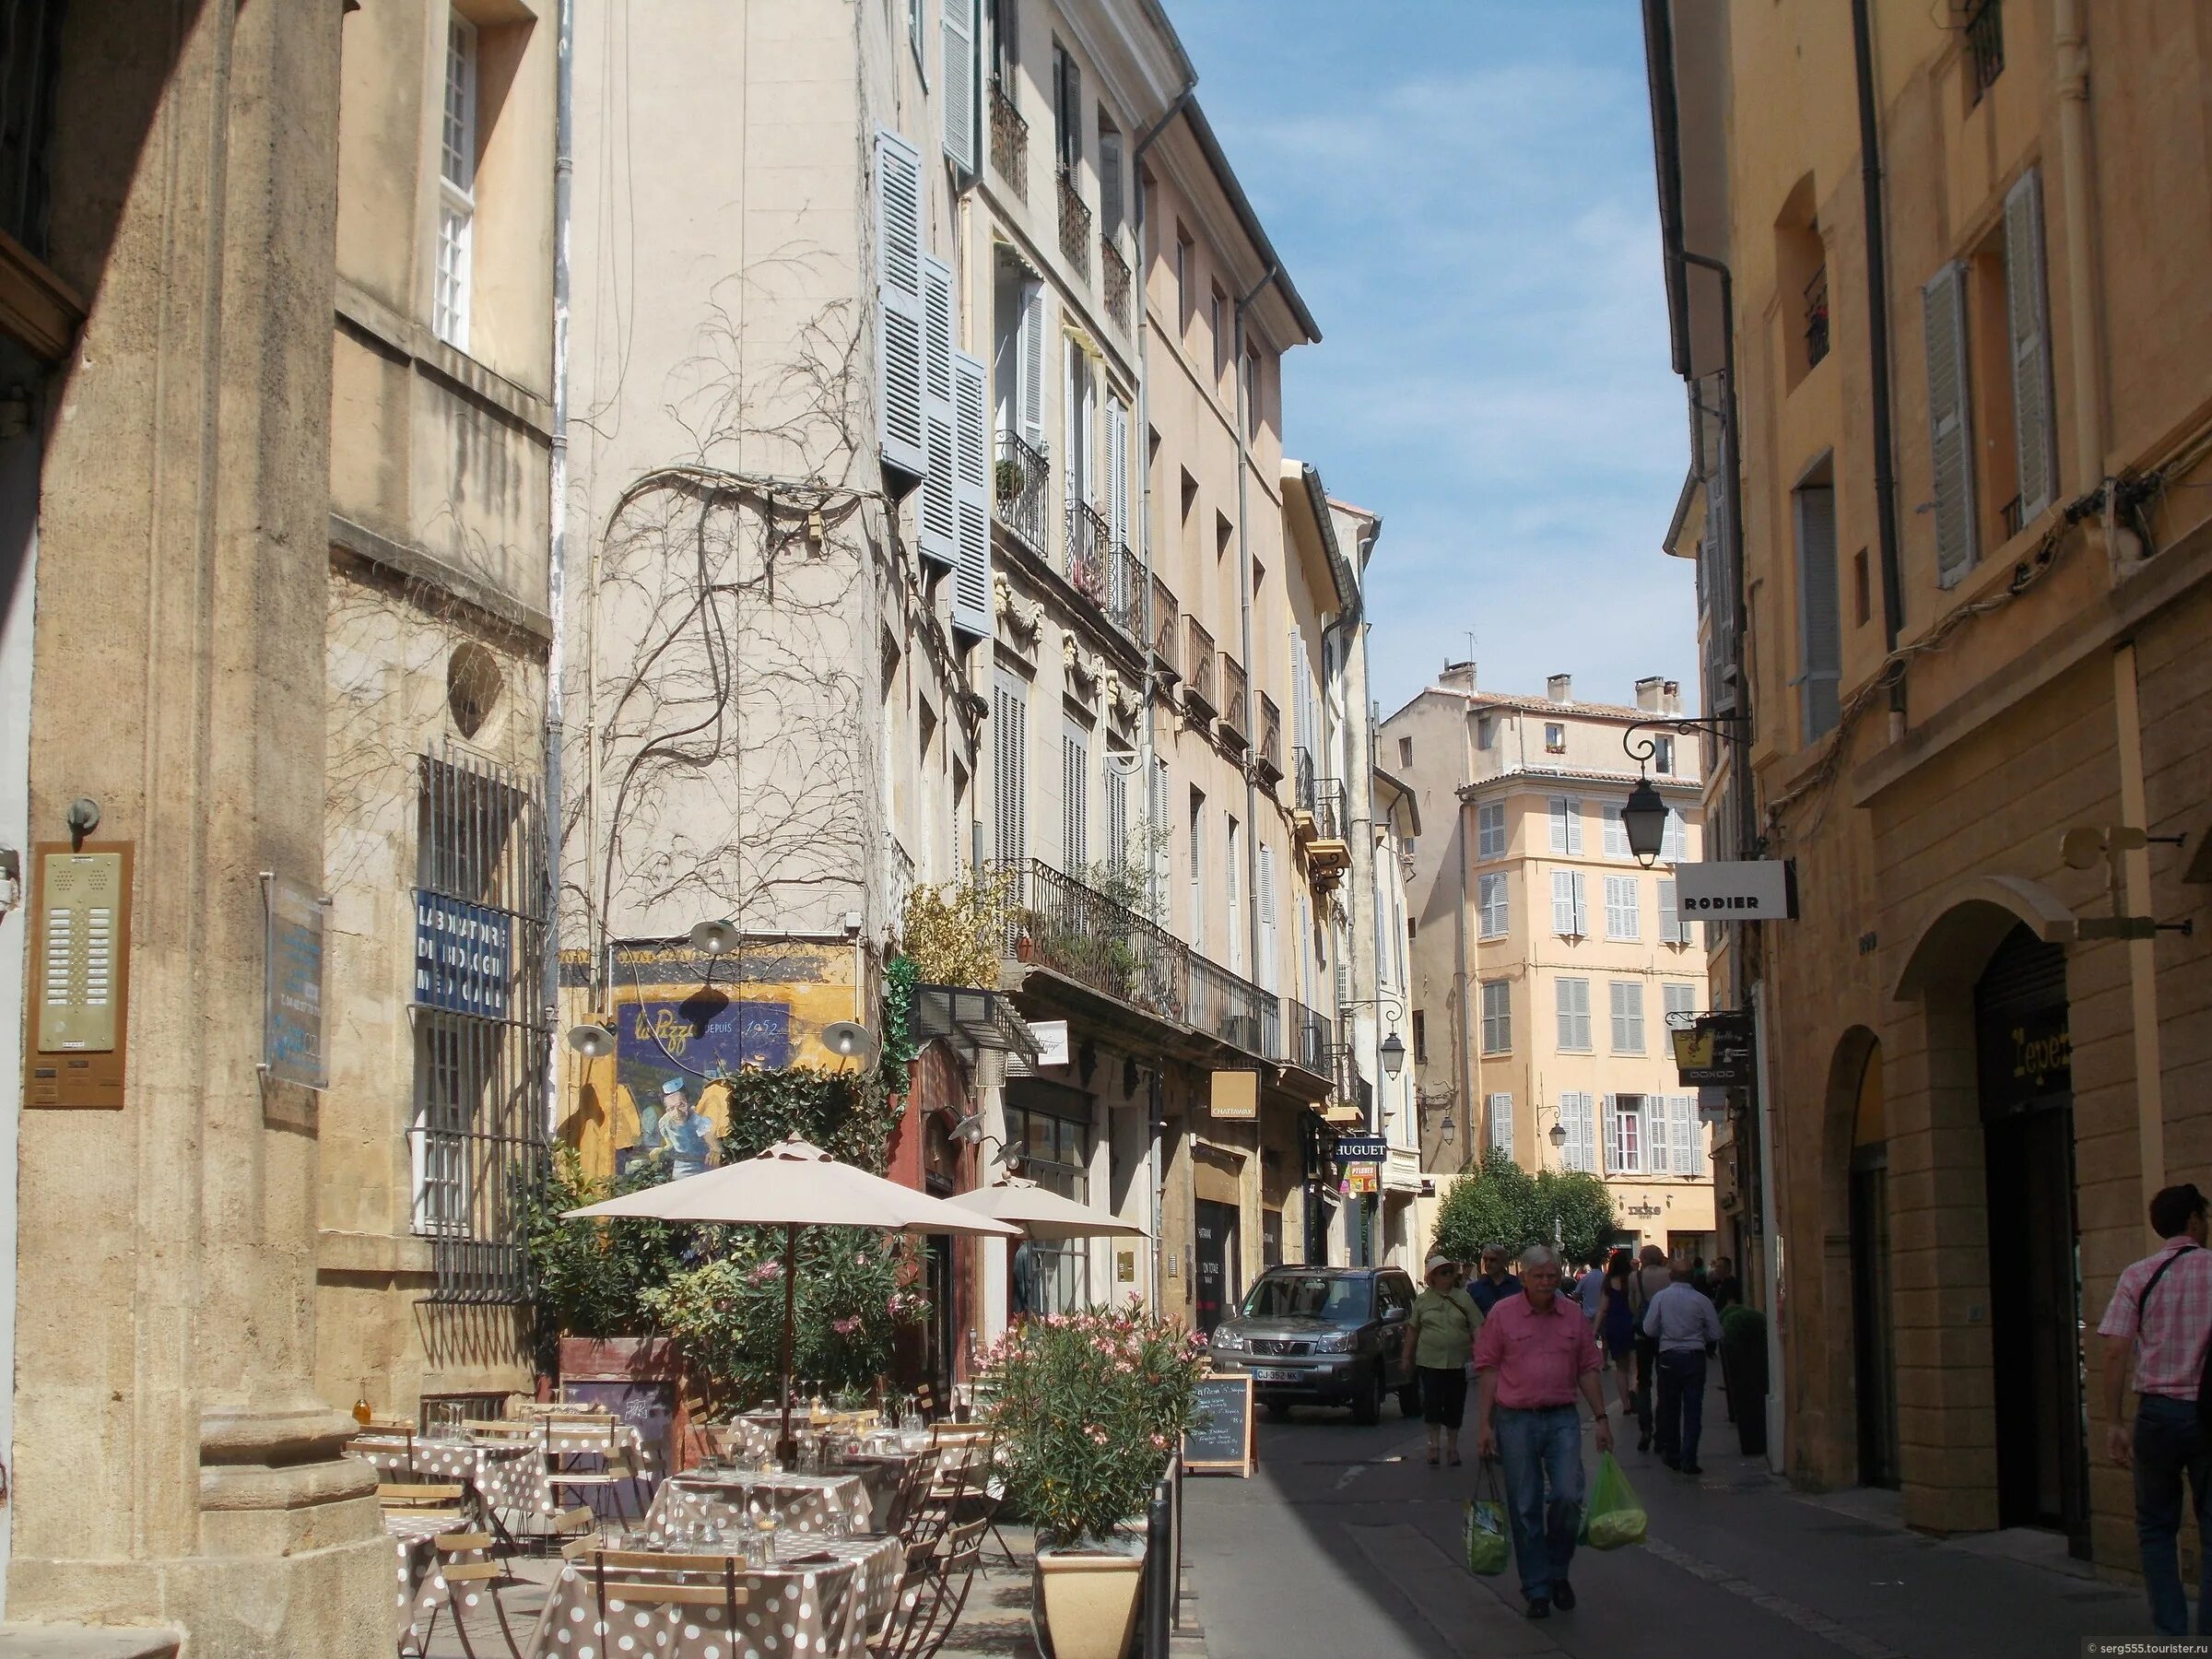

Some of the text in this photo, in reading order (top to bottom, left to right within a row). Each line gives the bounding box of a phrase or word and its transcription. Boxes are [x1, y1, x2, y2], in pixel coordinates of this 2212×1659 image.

[1685, 897, 1759, 910] RODIER
[745, 1019, 777, 1038] 1952
[1336, 1145, 1385, 1156] HUGUET
[1628, 1206, 1661, 1215] IKKS
